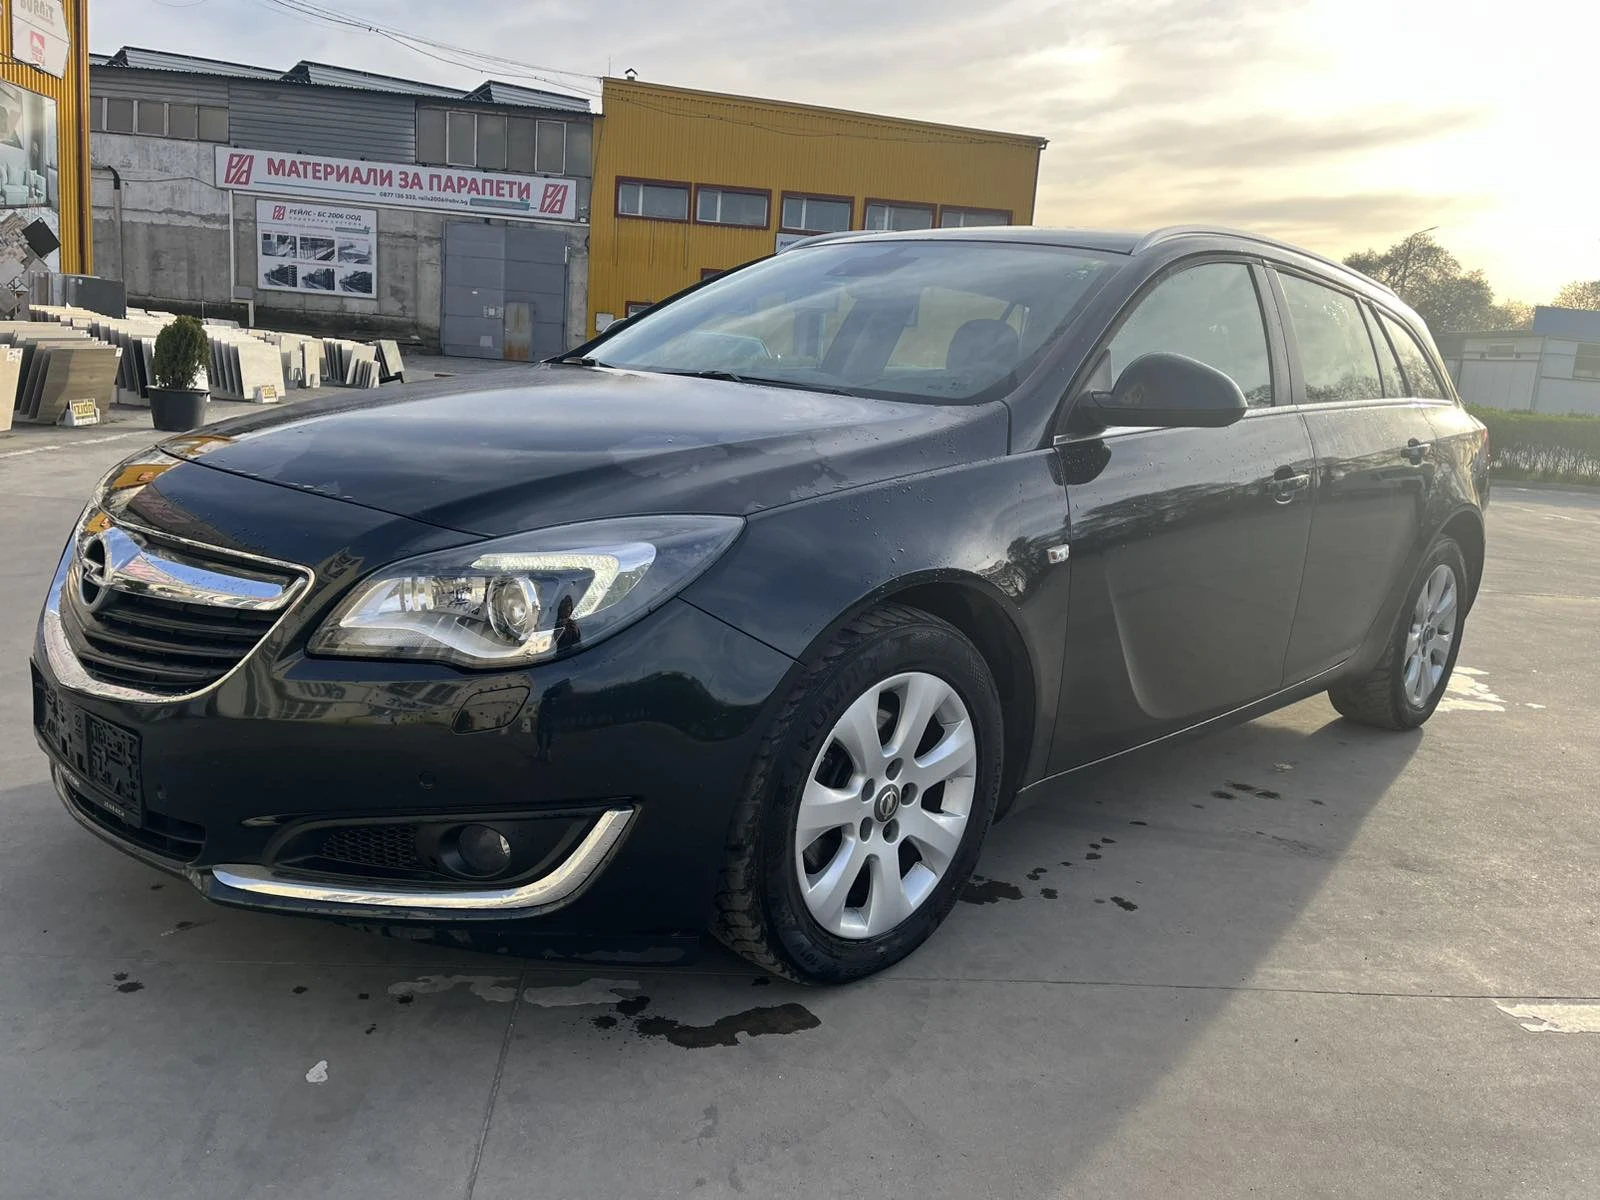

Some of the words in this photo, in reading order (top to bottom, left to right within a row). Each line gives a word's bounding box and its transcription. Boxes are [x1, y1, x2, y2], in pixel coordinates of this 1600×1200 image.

[267, 157, 393, 188] МАТЕРИАЛИ
[399, 170, 424, 191] ЗА
[429, 175, 531, 200] ПАРАПЕТИ
[289, 208, 312, 217] РЕЙЛС
